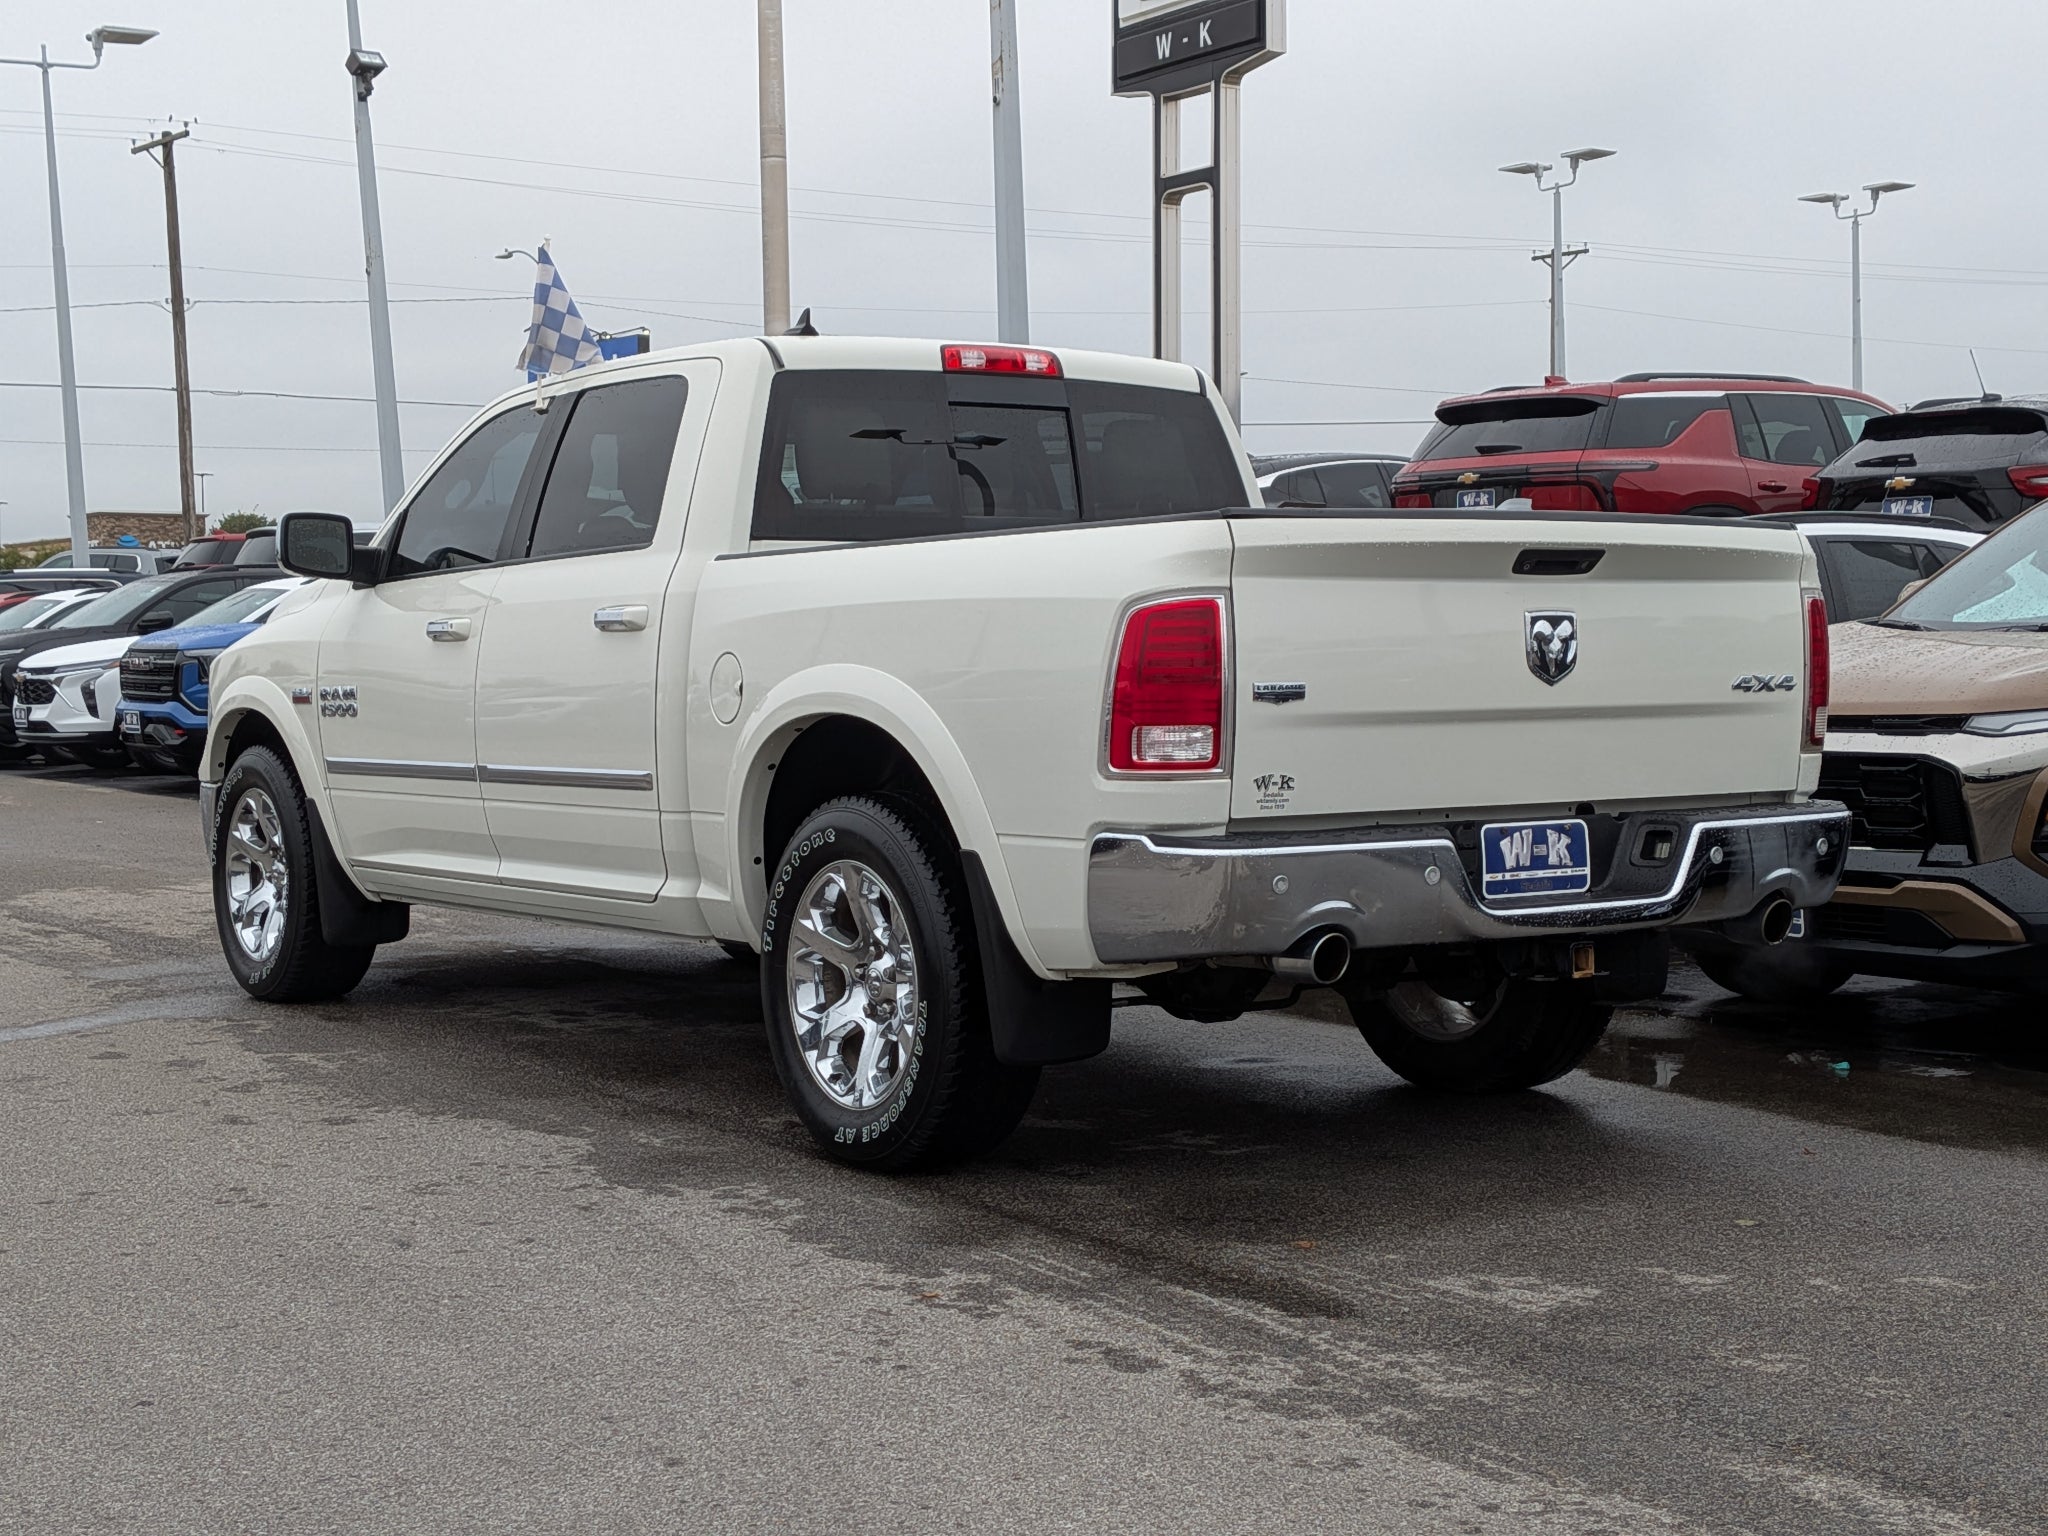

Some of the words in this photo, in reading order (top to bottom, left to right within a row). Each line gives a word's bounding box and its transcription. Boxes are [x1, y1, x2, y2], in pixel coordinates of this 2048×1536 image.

[1463, 491, 1489, 507] W-K
[1890, 499, 1925, 514] W-K
[320, 684, 358, 701] RAM
[320, 702, 358, 717] 1500
[1253, 773, 1295, 792] W-K
[1500, 828, 1574, 870] W-K
